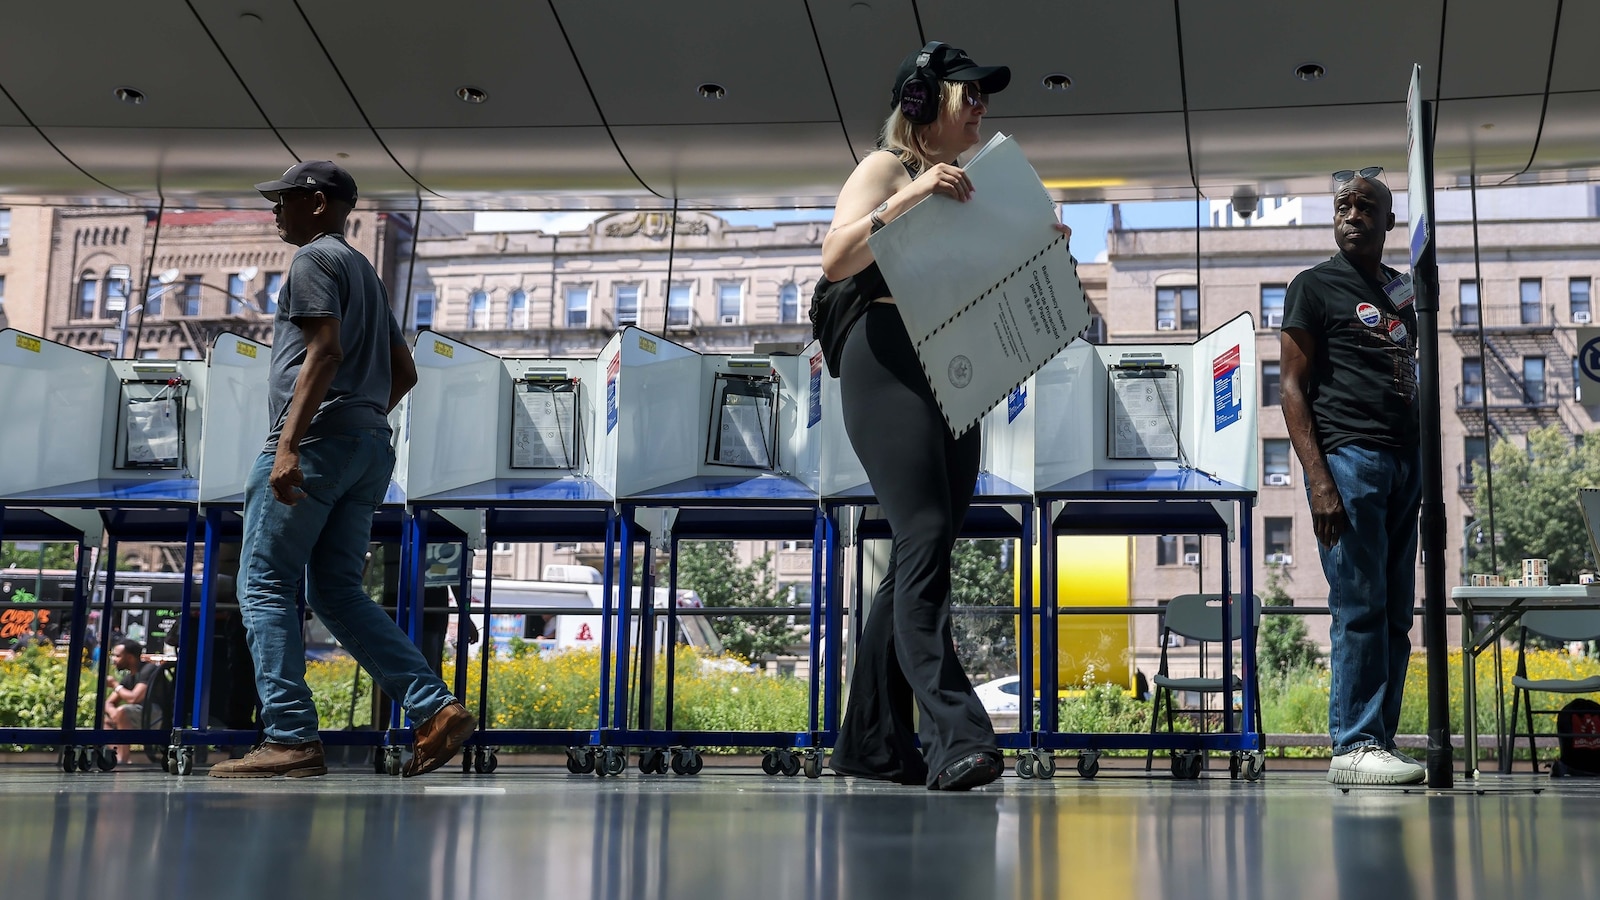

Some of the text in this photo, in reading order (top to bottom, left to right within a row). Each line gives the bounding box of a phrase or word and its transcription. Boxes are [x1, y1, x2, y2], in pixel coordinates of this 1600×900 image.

[1033, 270, 1060, 339] Carpeta de Privacidad
[1038, 306, 1050, 334] Papeleta
[1042, 265, 1066, 331] Ballot Privacy Sleeve
